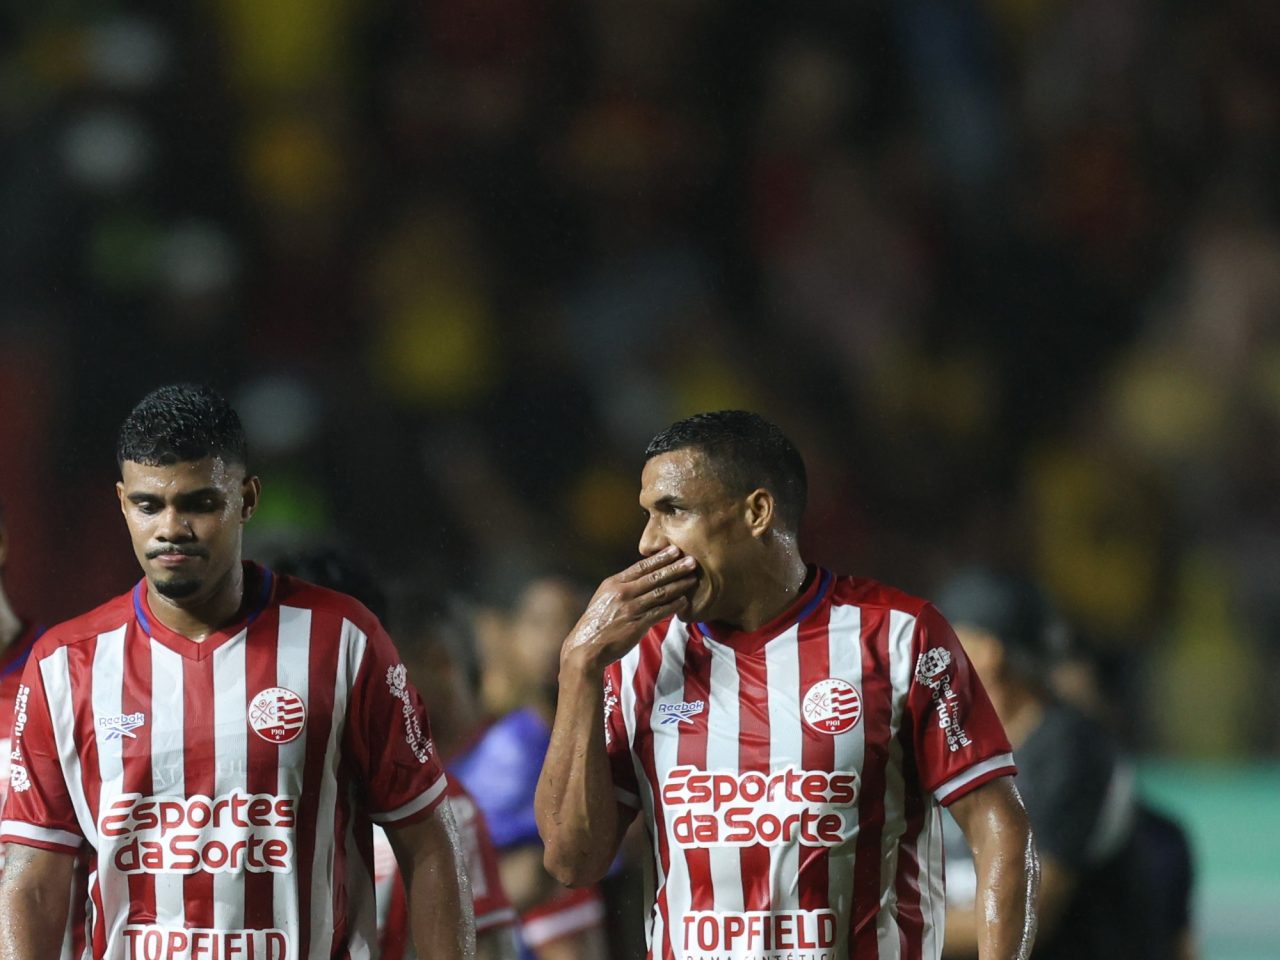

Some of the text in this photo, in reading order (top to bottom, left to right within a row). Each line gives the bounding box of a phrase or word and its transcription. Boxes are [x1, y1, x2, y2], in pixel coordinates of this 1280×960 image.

[99, 712, 144, 727] Reebok
[658, 701, 704, 713] Reebok
[929, 680, 959, 752] Português
[940, 674, 972, 747] Real Hospital
[271, 728, 285, 737] 1901
[663, 767, 856, 812] Esportes
[100, 792, 295, 838] Esportes
[673, 807, 844, 843] da Sorte
[114, 834, 288, 871] da Sorte
[683, 914, 837, 951] TOPFIELD
